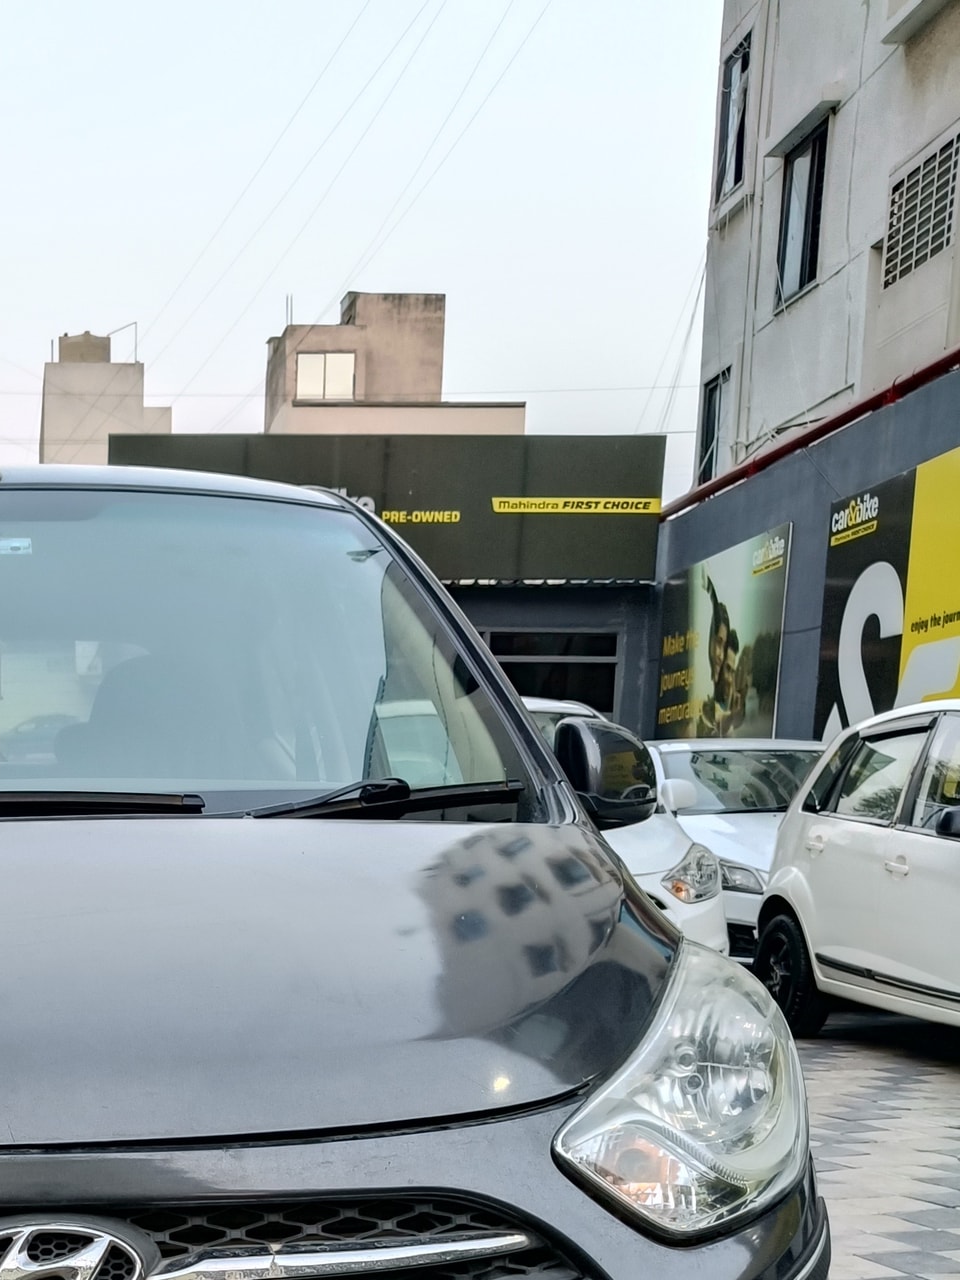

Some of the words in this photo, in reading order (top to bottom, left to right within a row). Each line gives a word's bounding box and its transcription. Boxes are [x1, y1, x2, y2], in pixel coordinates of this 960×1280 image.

[498, 500, 559, 511] Mahindra
[561, 501, 602, 510] FIRST
[603, 501, 651, 510] CHOICE
[832, 493, 879, 533] car&bike
[382, 511, 461, 524] PRE-OWNED
[911, 617, 929, 635] enjoy
[930, 612, 941, 628] the
[662, 632, 685, 657] Make
